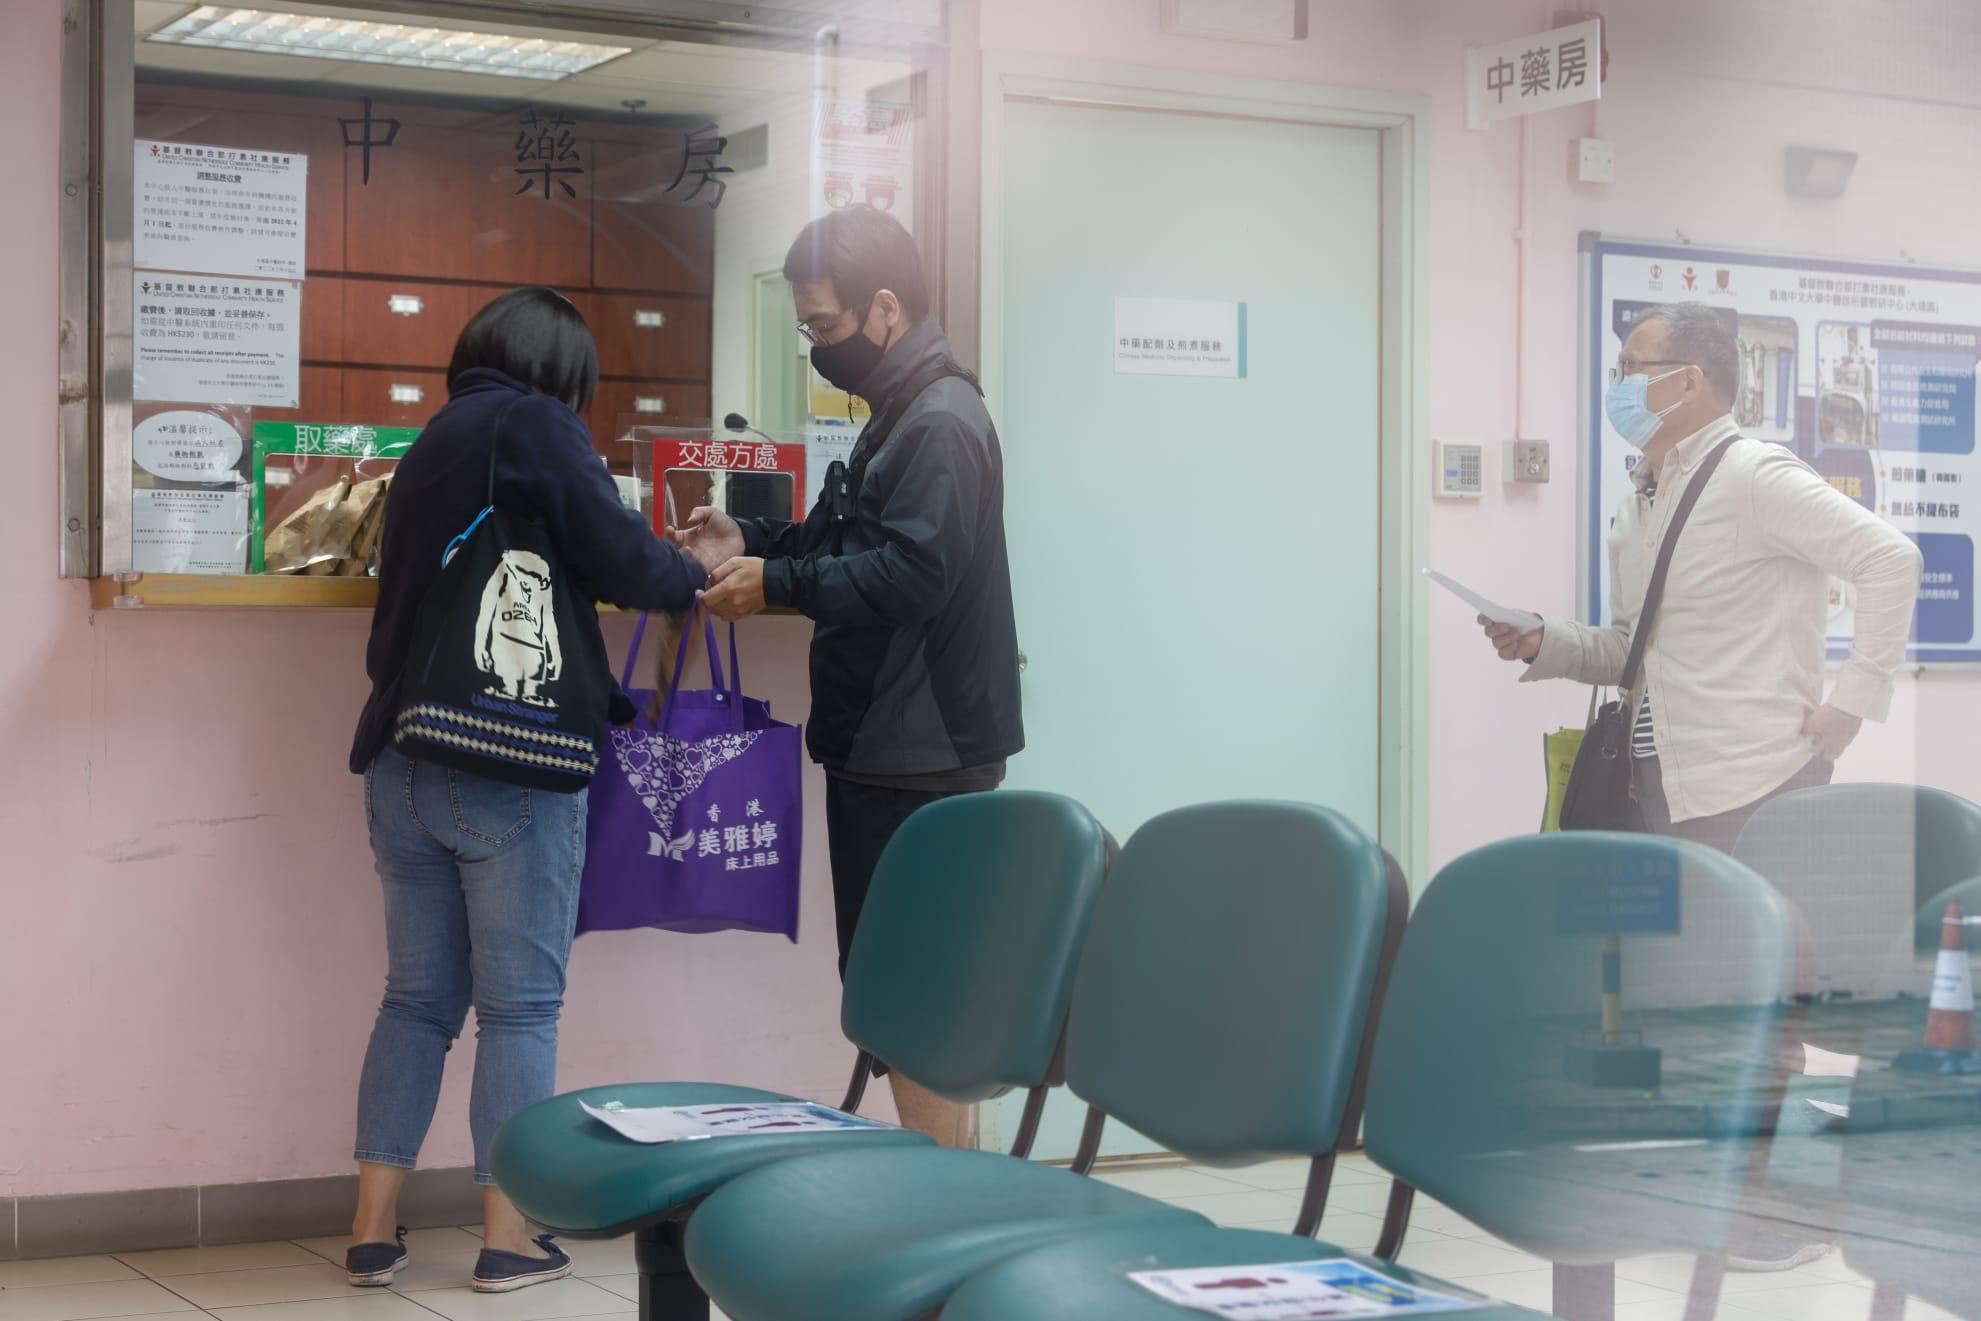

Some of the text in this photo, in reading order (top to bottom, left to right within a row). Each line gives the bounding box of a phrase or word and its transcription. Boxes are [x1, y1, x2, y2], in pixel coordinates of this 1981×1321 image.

[1487, 38, 1588, 104] 中藥房
[337, 95, 735, 210] 中藥房
[295, 424, 378, 454] 取藥處
[678, 440, 778, 470] 交處方處
[706, 798, 765, 823] 香港
[698, 820, 778, 858] 美雅婷
[725, 850, 780, 871] 床上用品
